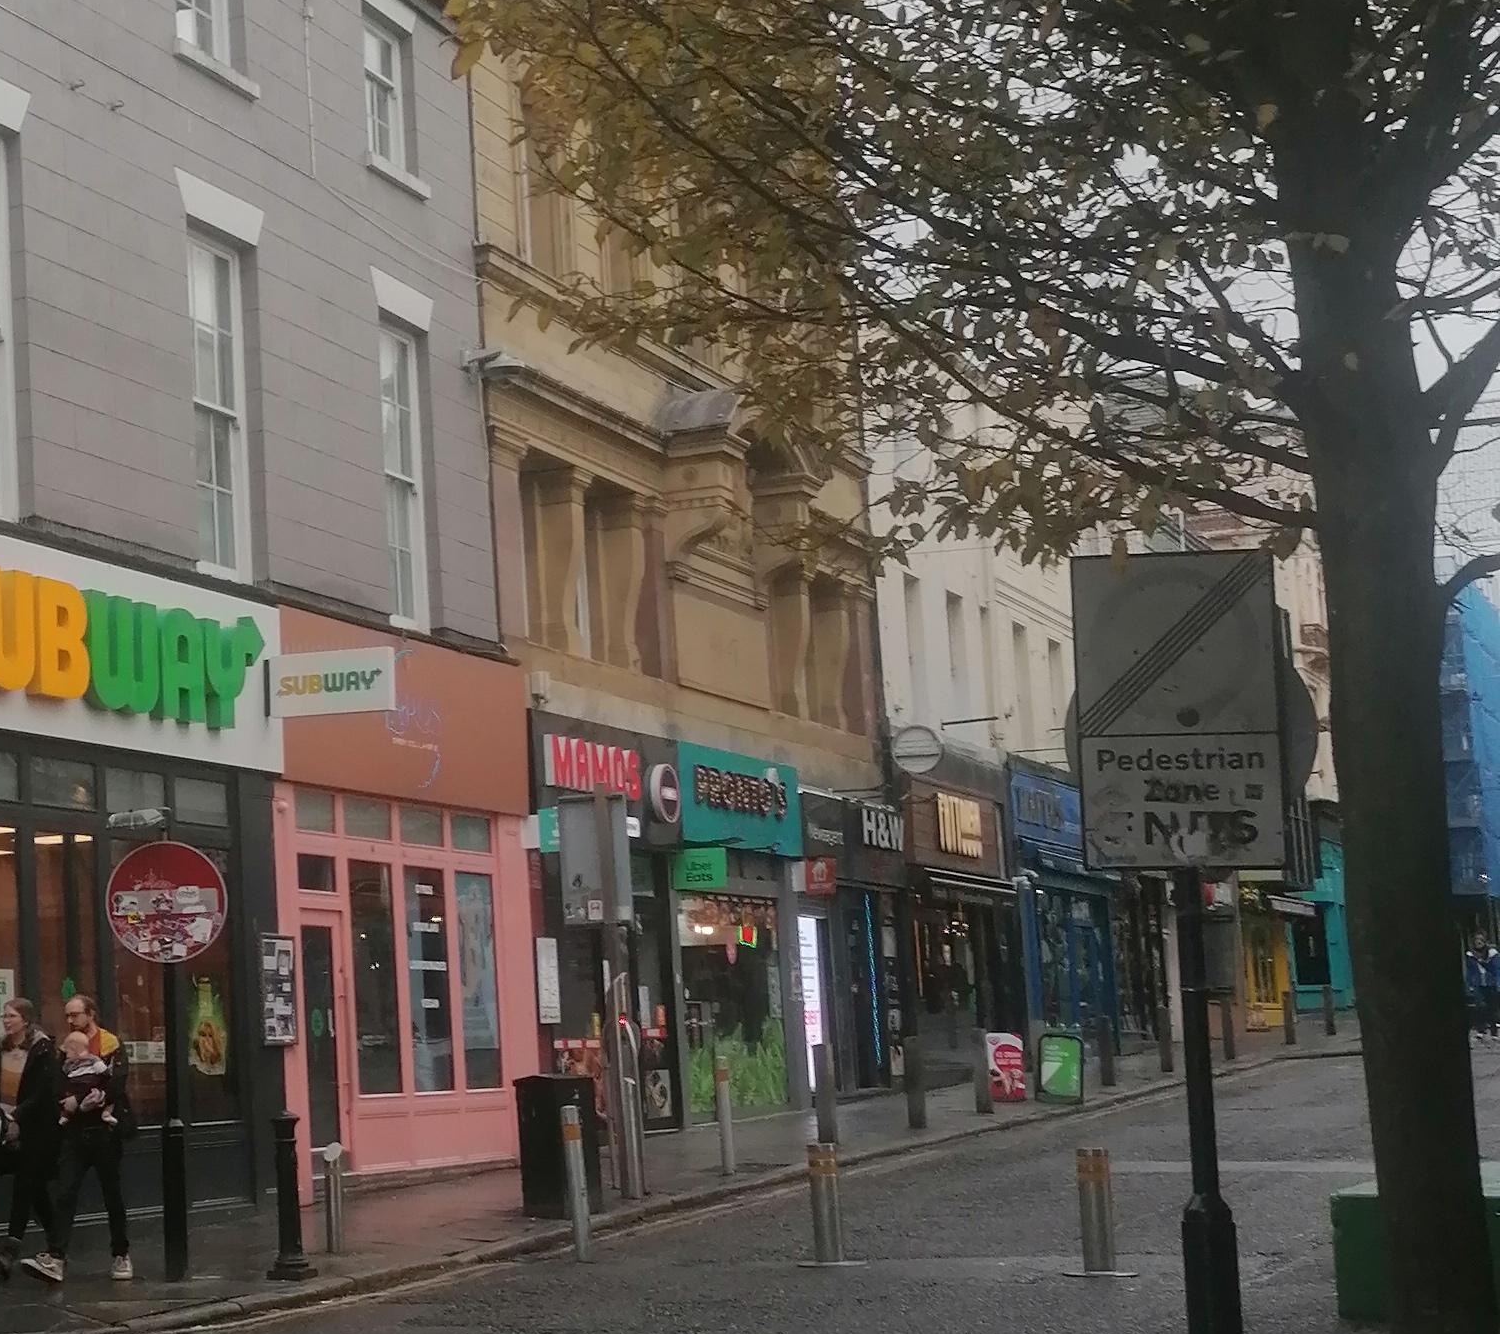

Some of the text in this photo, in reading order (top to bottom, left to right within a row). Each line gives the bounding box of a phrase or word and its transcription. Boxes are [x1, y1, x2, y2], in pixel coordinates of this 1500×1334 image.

[276, 668, 382, 697] SUBWAY
[1096, 747, 1266, 772] Pedestrian
[1143, 778, 1220, 803] Zone
[686, 872, 714, 883] Eats
